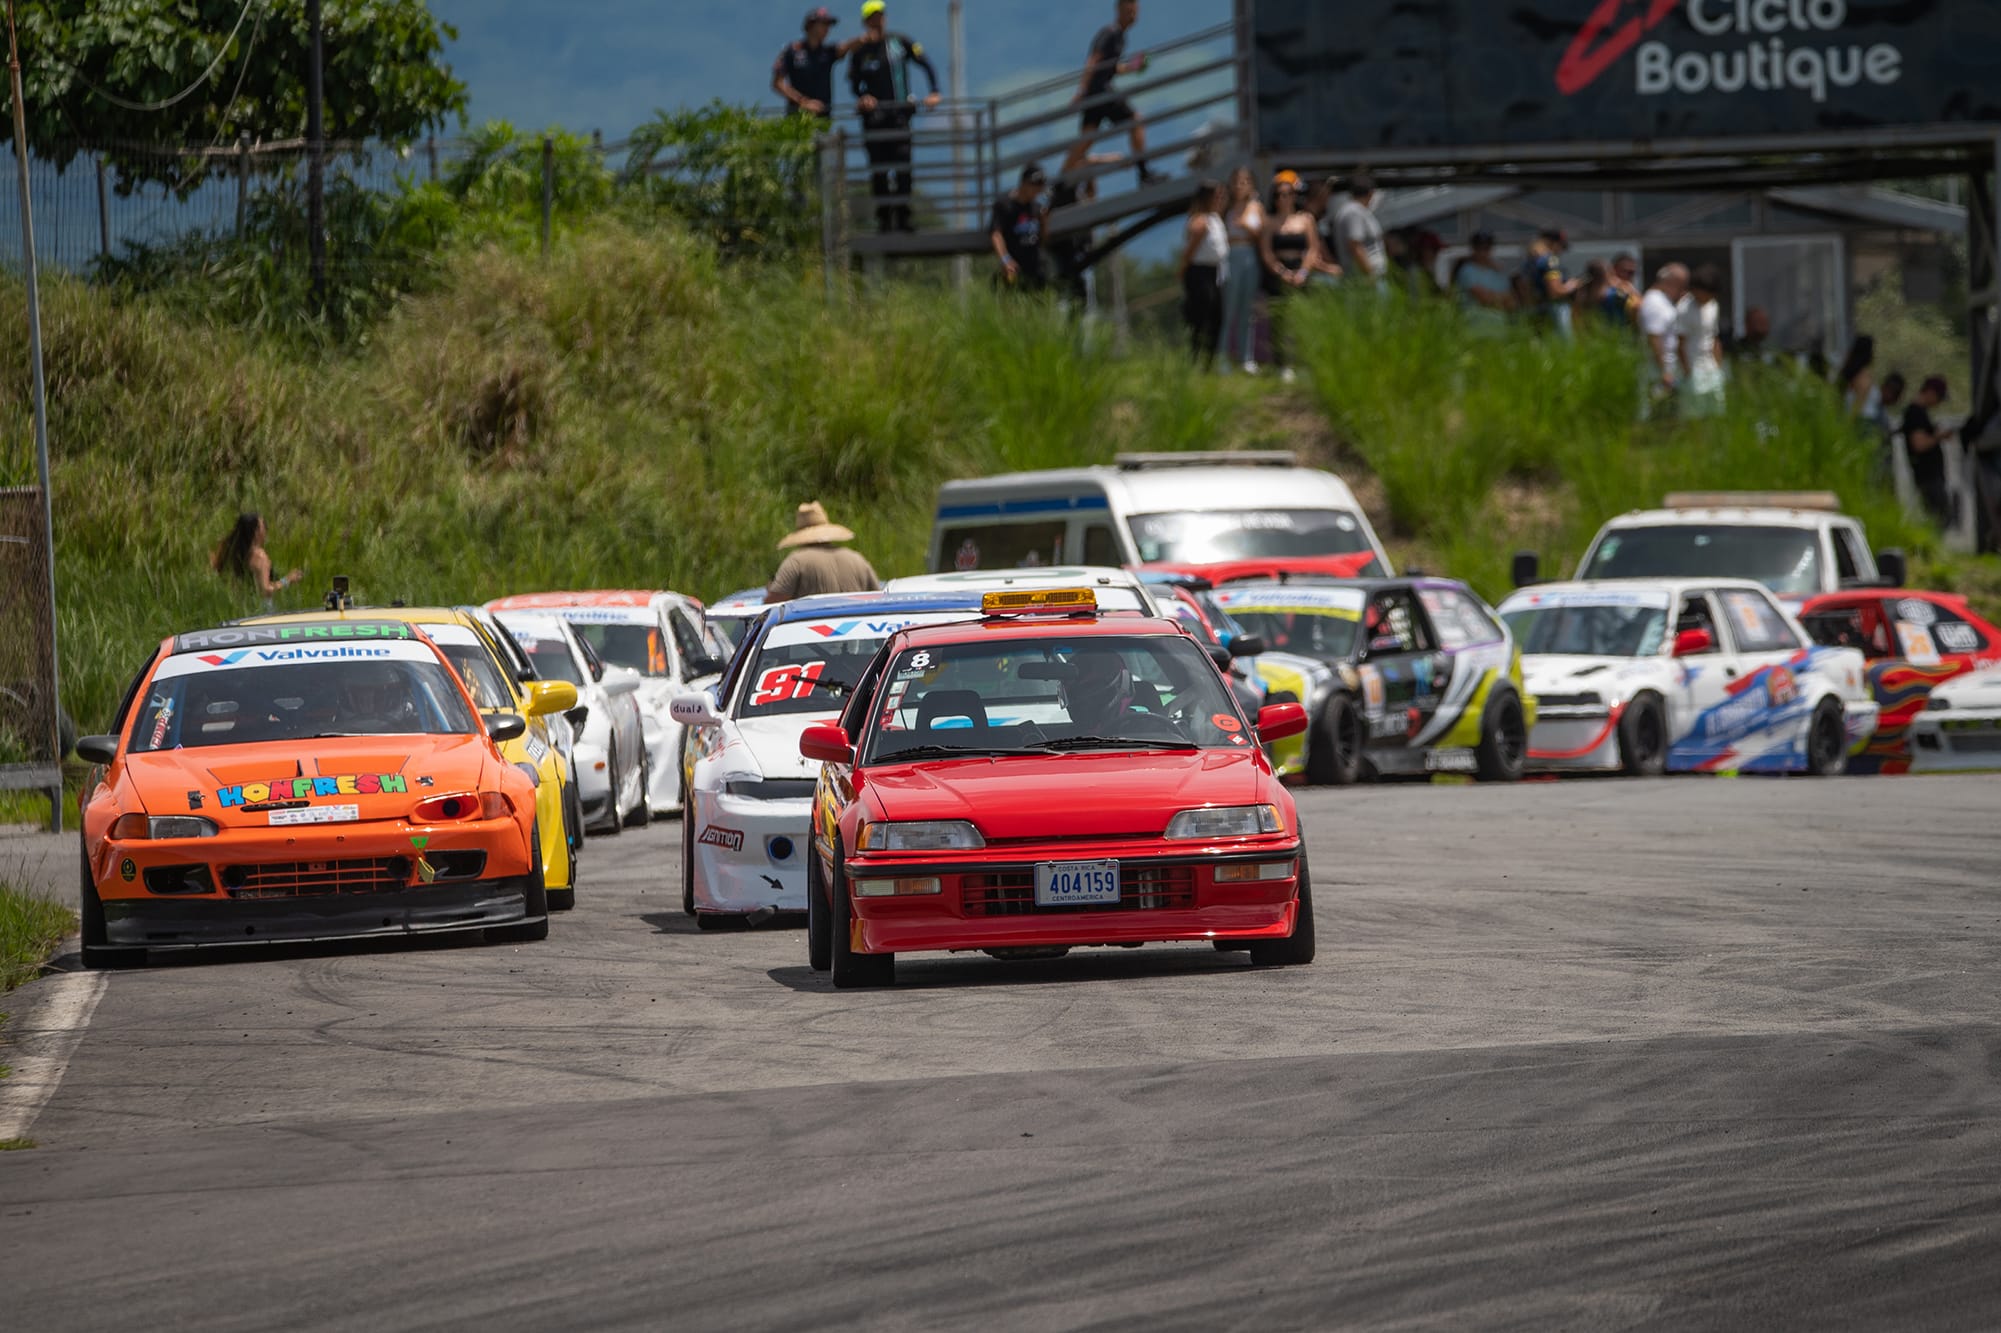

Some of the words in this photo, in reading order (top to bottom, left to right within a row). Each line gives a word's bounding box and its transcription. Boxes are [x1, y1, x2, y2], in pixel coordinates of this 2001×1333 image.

[1686, 0, 1847, 35] Ciclo
[1635, 36, 1903, 102] Boutique
[181, 624, 408, 650] HONFRESH
[257, 646, 391, 661] Valvoline
[910, 653, 931, 668] 8
[749, 660, 826, 706] 91
[673, 703, 695, 714] dual
[216, 774, 408, 808] HONFRESH
[1058, 864, 1079, 873] COSTA
[1080, 864, 1096, 872] RICA
[1049, 871, 1115, 894] 404159
[1051, 894, 1105, 902] CENTROAMERICA
